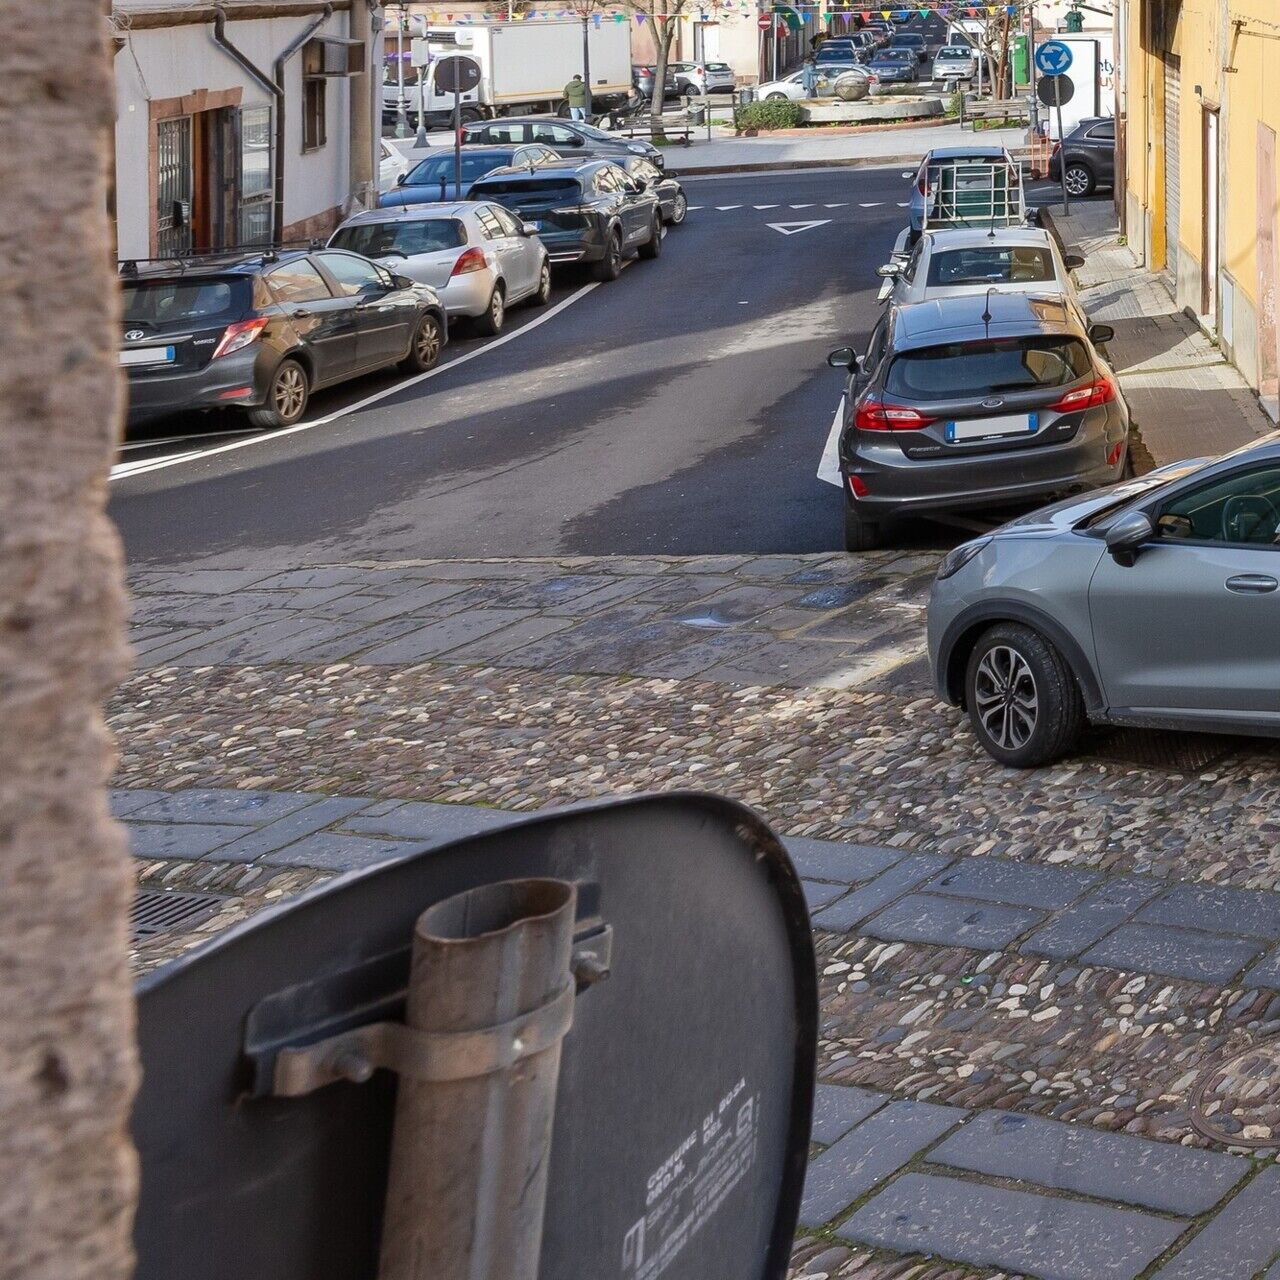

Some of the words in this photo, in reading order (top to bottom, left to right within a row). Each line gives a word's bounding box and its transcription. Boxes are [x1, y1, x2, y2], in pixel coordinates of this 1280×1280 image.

[647, 1129, 698, 1190] COMUNE
[702, 1111, 714, 1132] DI
[718, 1076, 746, 1114] BOSA
